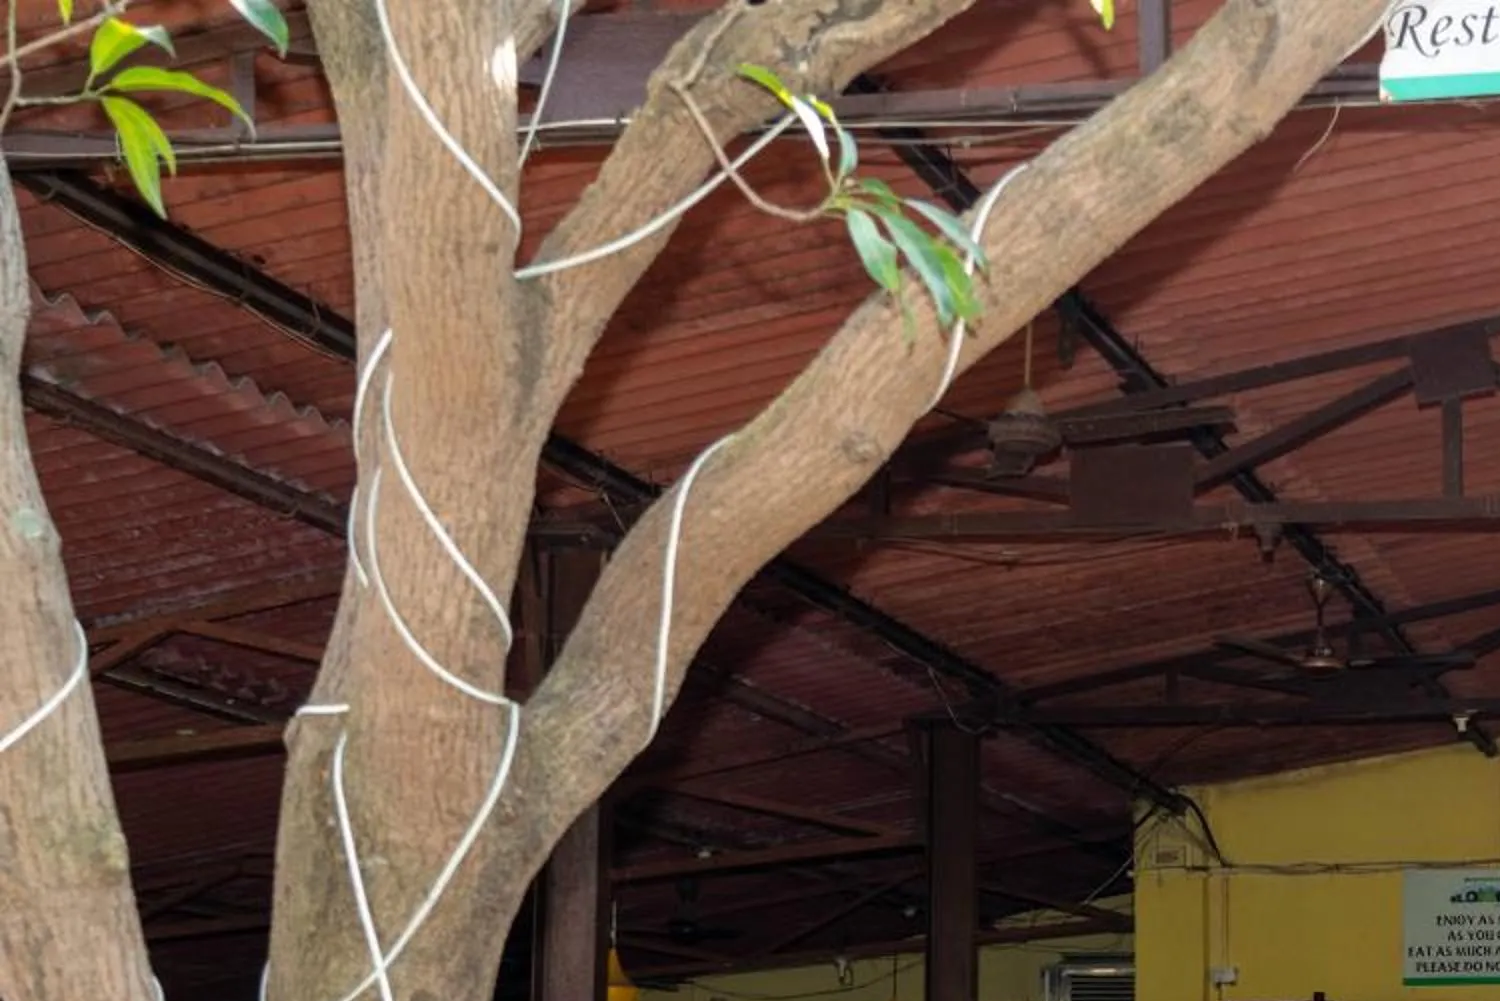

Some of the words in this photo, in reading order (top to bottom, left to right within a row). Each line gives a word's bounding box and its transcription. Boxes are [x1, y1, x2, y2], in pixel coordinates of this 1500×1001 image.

[1436, 914, 1474, 926] ENJOY
[1477, 914, 1495, 926] AS
[1448, 930, 1464, 941] AS
[1468, 930, 1495, 940] YOU
[1408, 946, 1433, 958] EAT
[1436, 946, 1453, 957] AS
[1456, 946, 1491, 957] MUCH
[1415, 961, 1461, 972] PLEASE
[1462, 961, 1483, 972] DO
